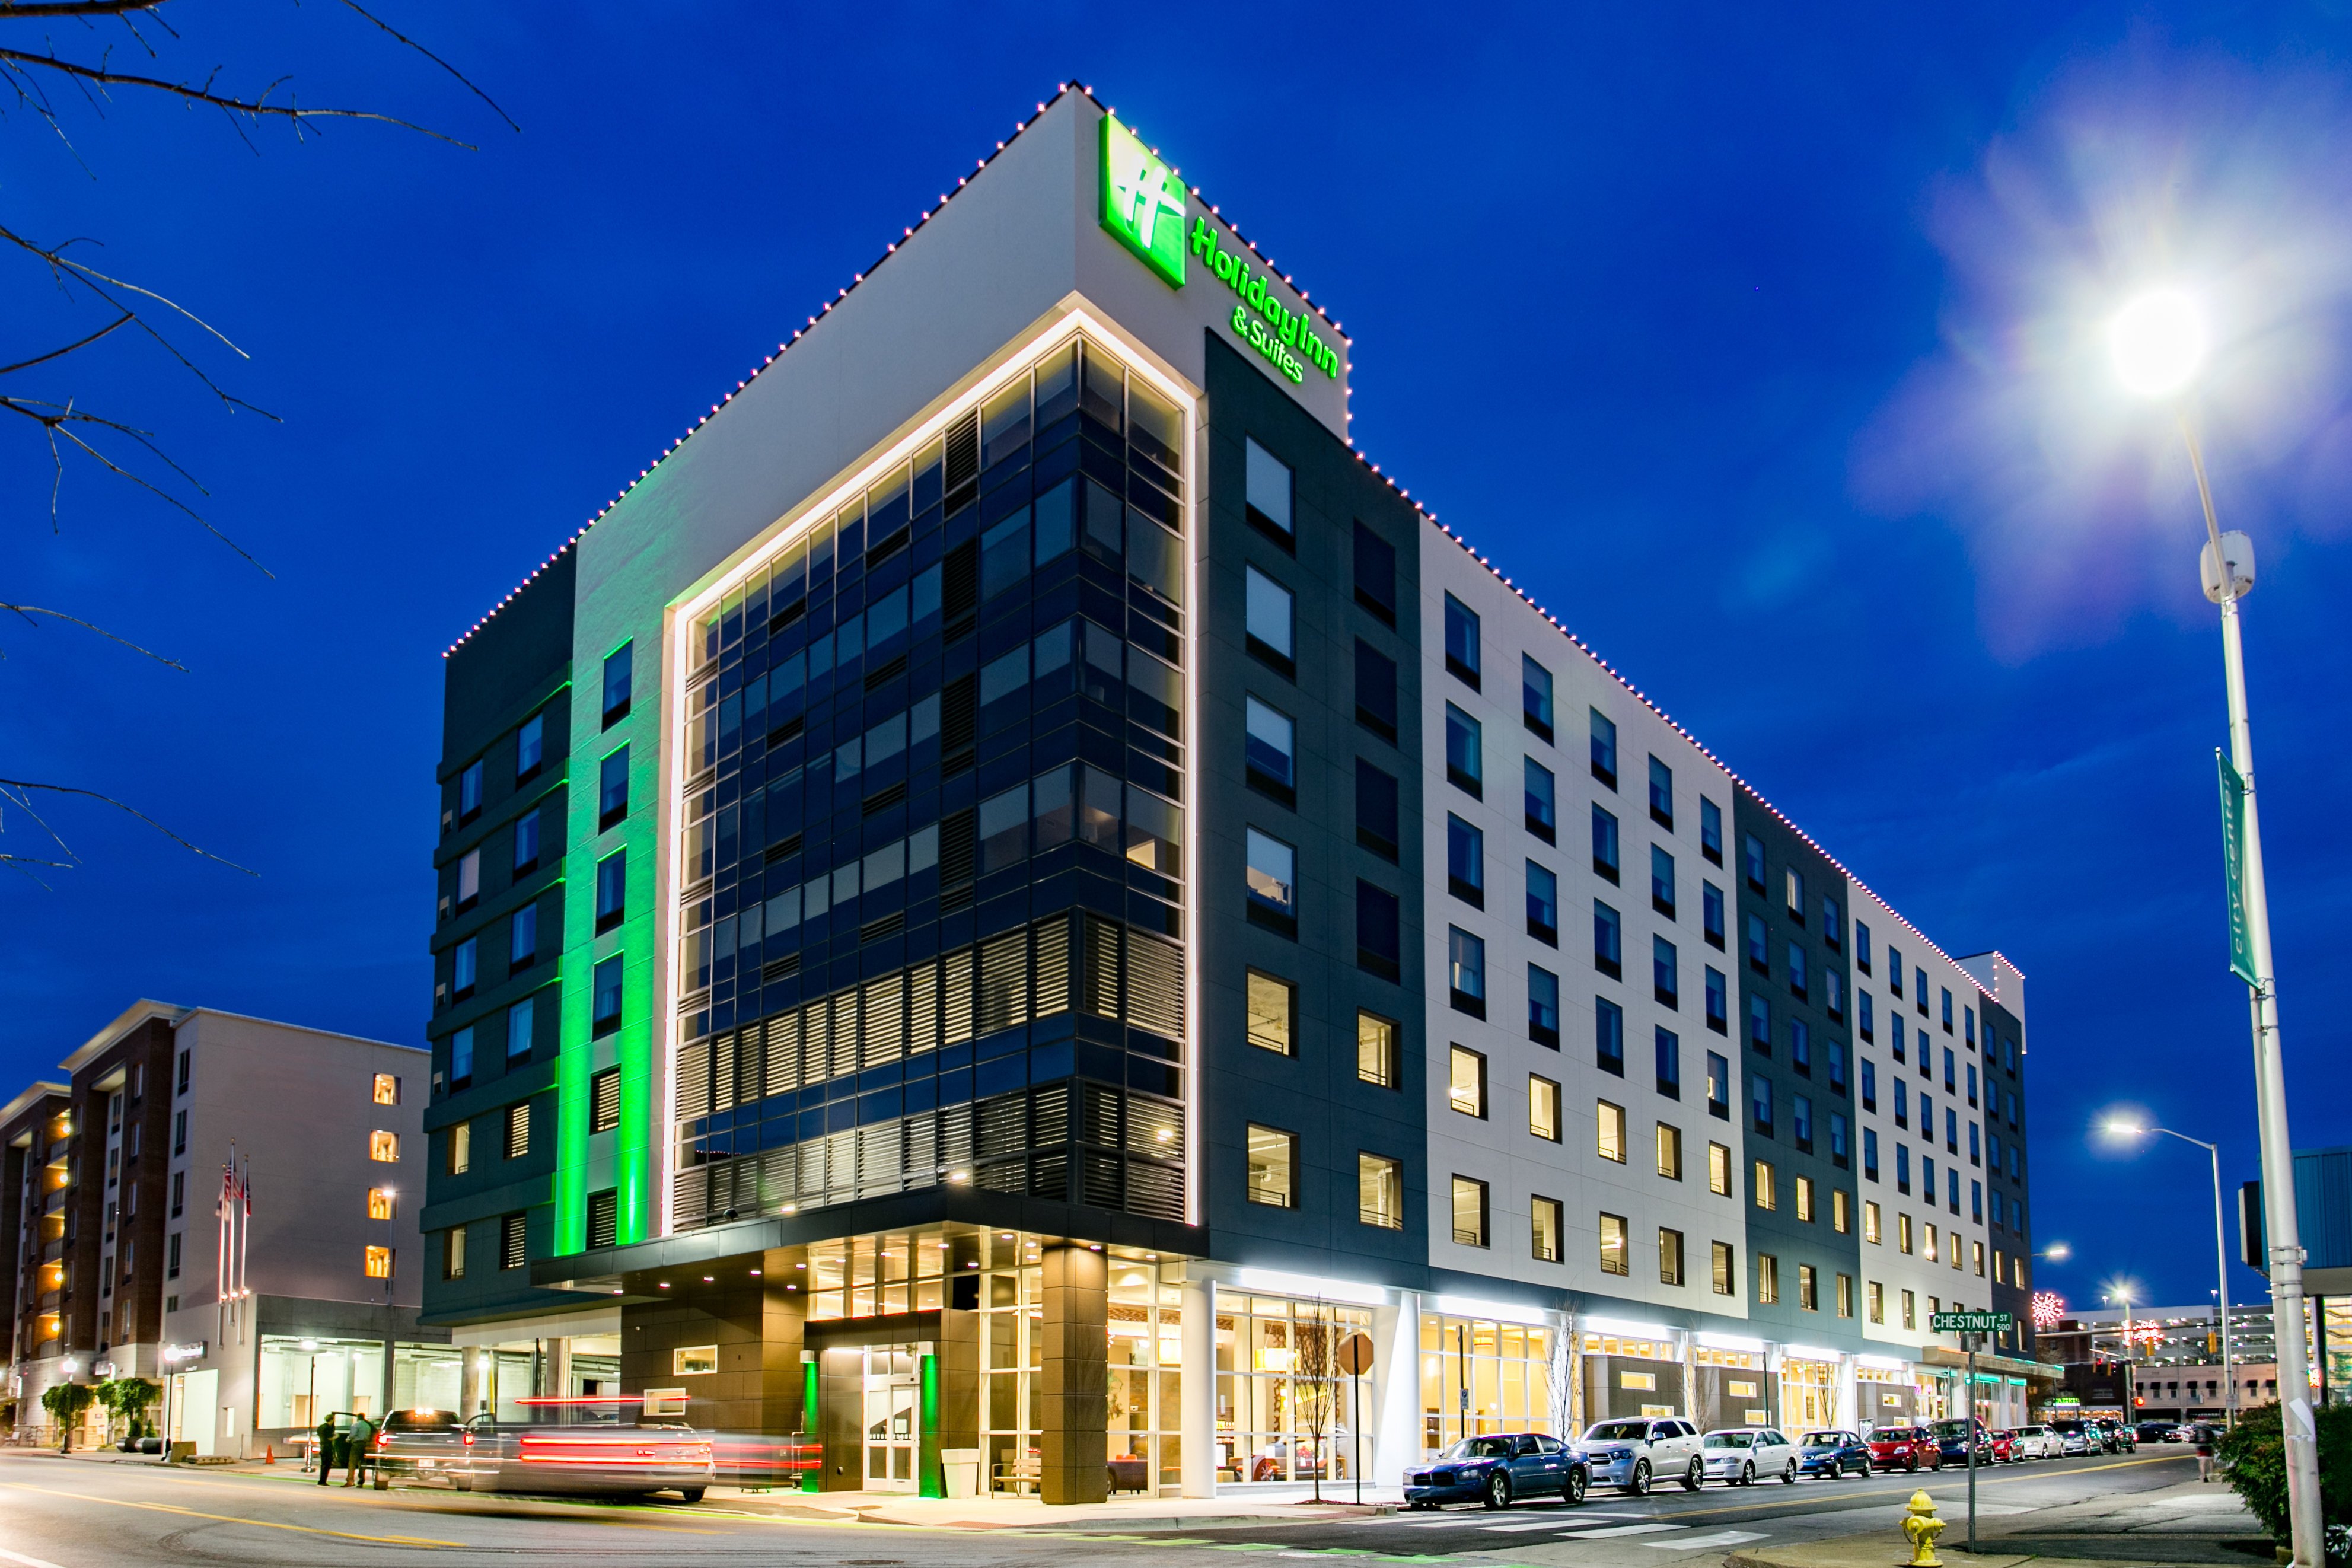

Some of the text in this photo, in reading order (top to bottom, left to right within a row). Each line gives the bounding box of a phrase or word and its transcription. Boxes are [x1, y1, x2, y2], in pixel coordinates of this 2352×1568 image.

[1190, 216, 1338, 379] Holiday Inn
[1232, 305, 1304, 384] & Suites
[2224, 772, 2242, 954] city center
[1933, 1315, 1997, 1328] CHESTNUT
